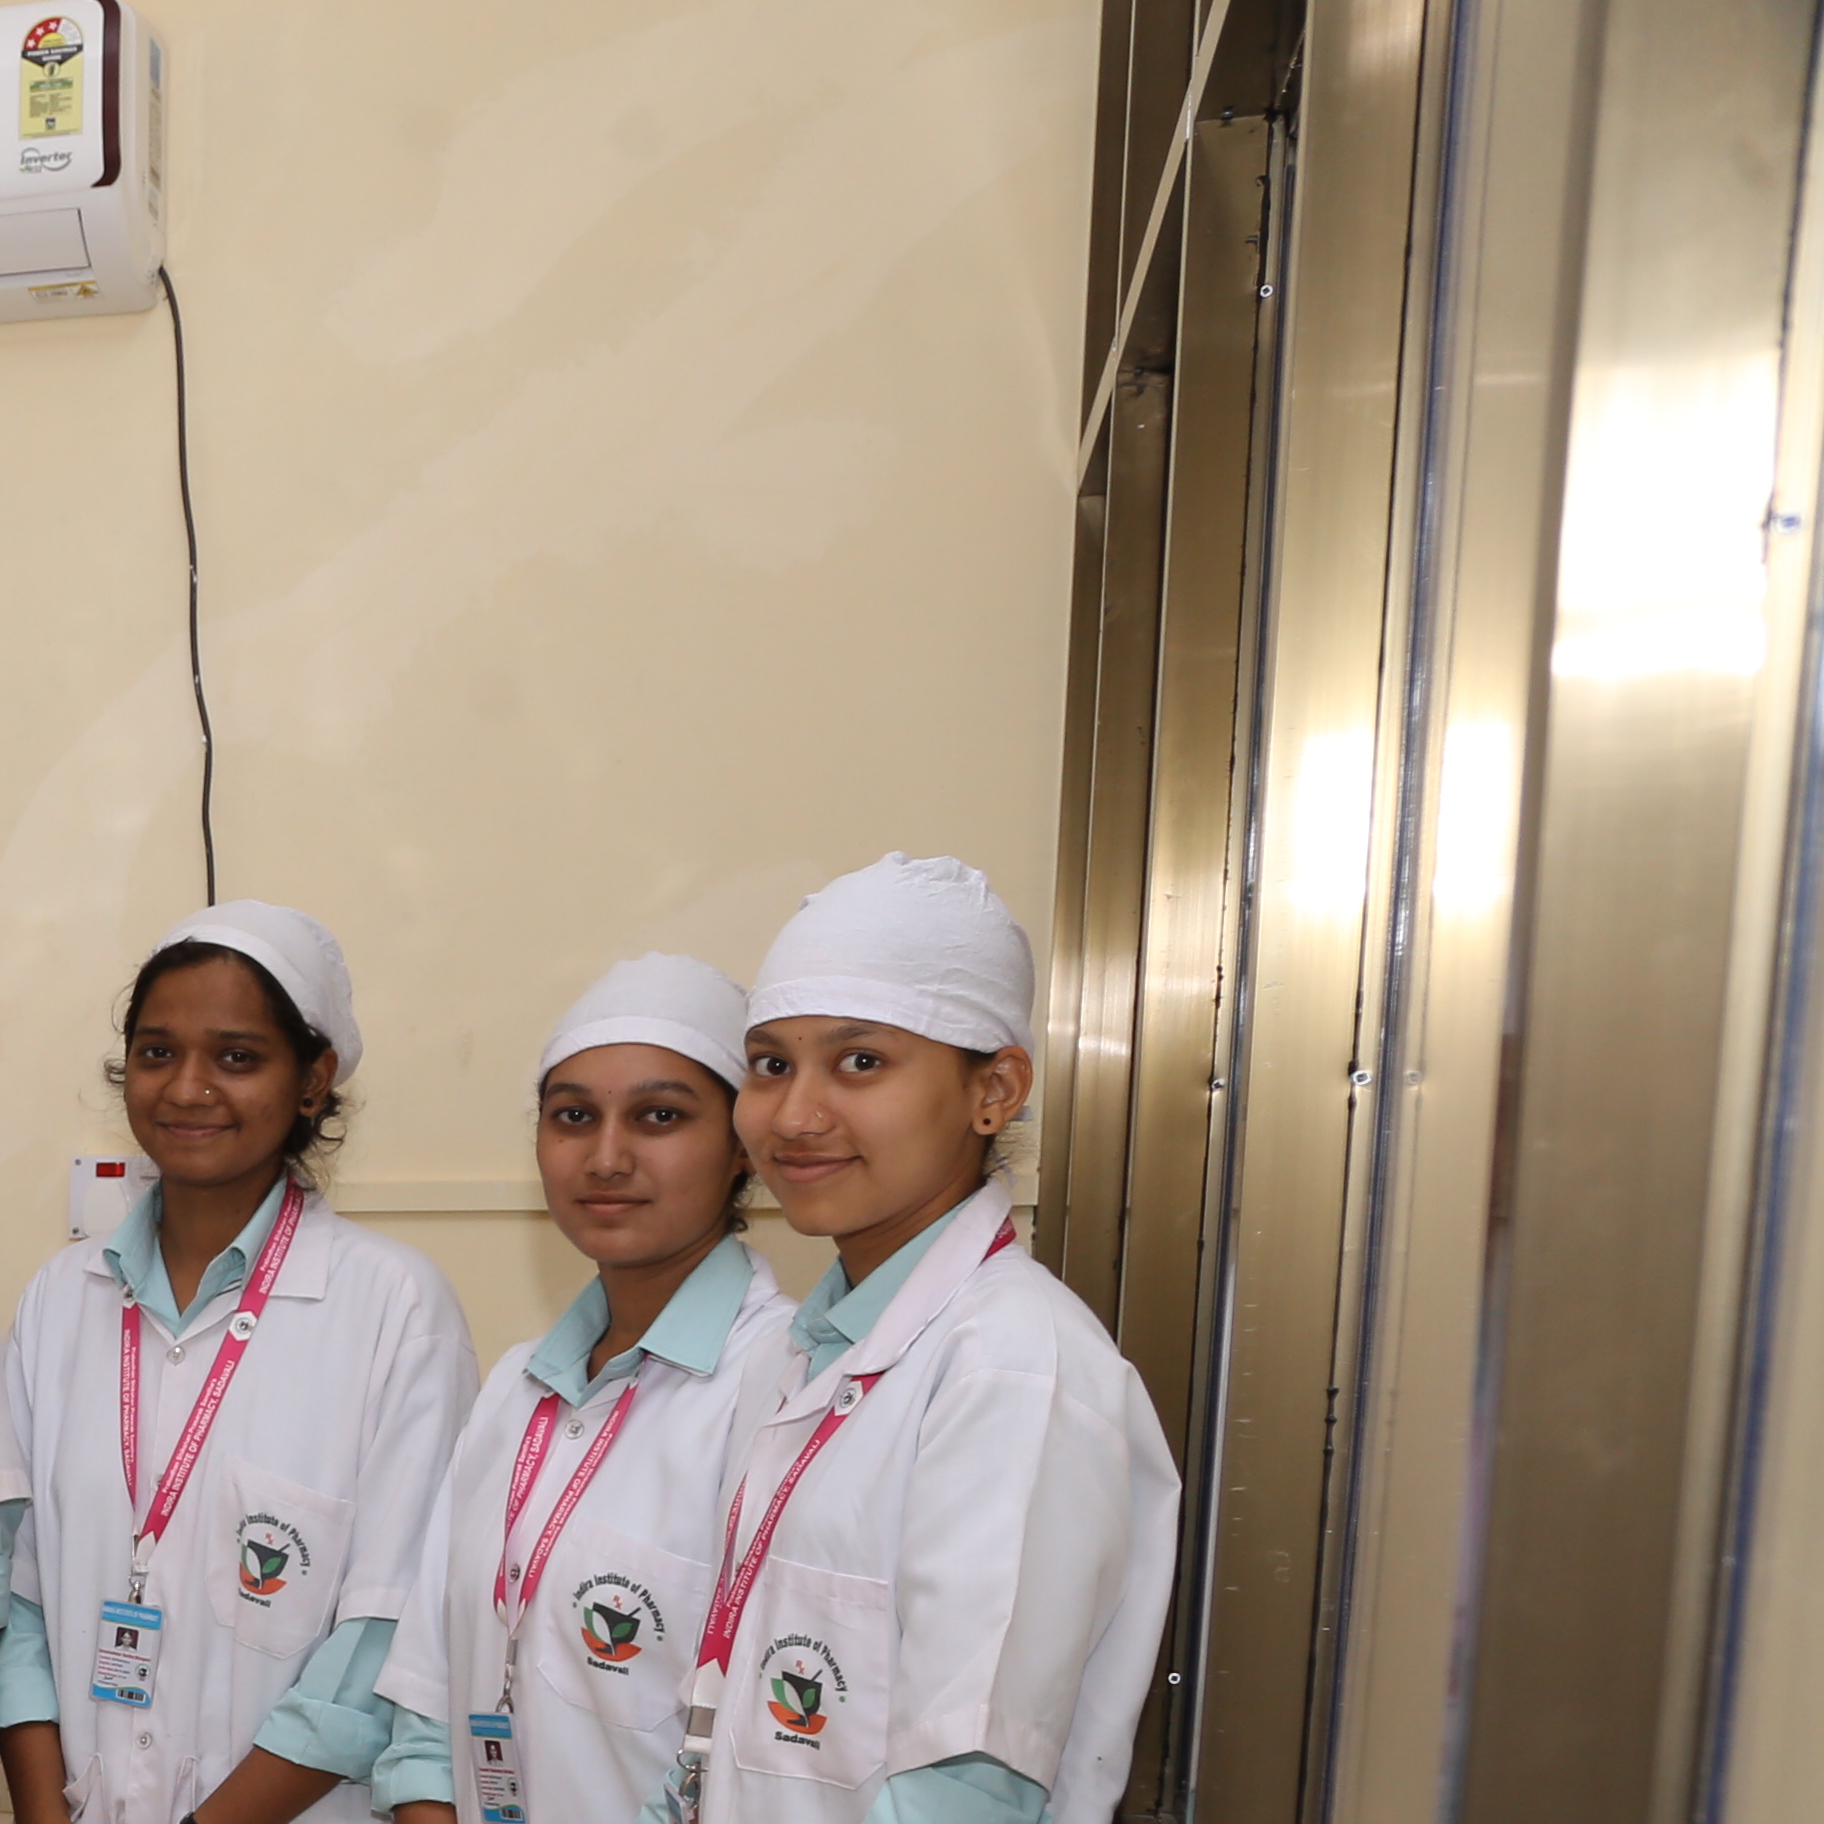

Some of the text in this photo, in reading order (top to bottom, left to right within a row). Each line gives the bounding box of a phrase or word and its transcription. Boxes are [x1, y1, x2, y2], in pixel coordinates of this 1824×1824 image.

[259, 1225, 292, 1293] INDIRA INSTITUTE OF
[122, 1393, 129, 1402] OF
[601, 1410, 619, 1437] INDIRA
[161, 1490, 177, 1516] INDIRA
[172, 1452, 193, 1490] INSTITUTE
[189, 1441, 198, 1452] OF
[213, 1359, 234, 1397] SADAVALI
[176, 1433, 191, 1460] Shikshan
[188, 1406, 203, 1433] Prasarak
[515, 1453, 536, 1498] PHARMACY,
[530, 1415, 548, 1452] SADAVALI
[578, 1437, 604, 1477] INSTITUTE
[571, 1477, 580, 1489] OF
[245, 1512, 311, 1567] Institute of Pharmacy
[527, 1537, 549, 1577] SADAVALI
[723, 1605, 739, 1638] INDIRA
[734, 1554, 758, 1605] INSTITUTE
[754, 1540, 763, 1554] OF
[787, 1439, 820, 1483] SADAVALI
[573, 1572, 665, 1633] Indira Institute of Pharmacy
[587, 1657, 629, 1676] Sadavali
[774, 1633, 848, 1692] Institute of Pharmacy
[774, 1731, 821, 1751] Sadavali
